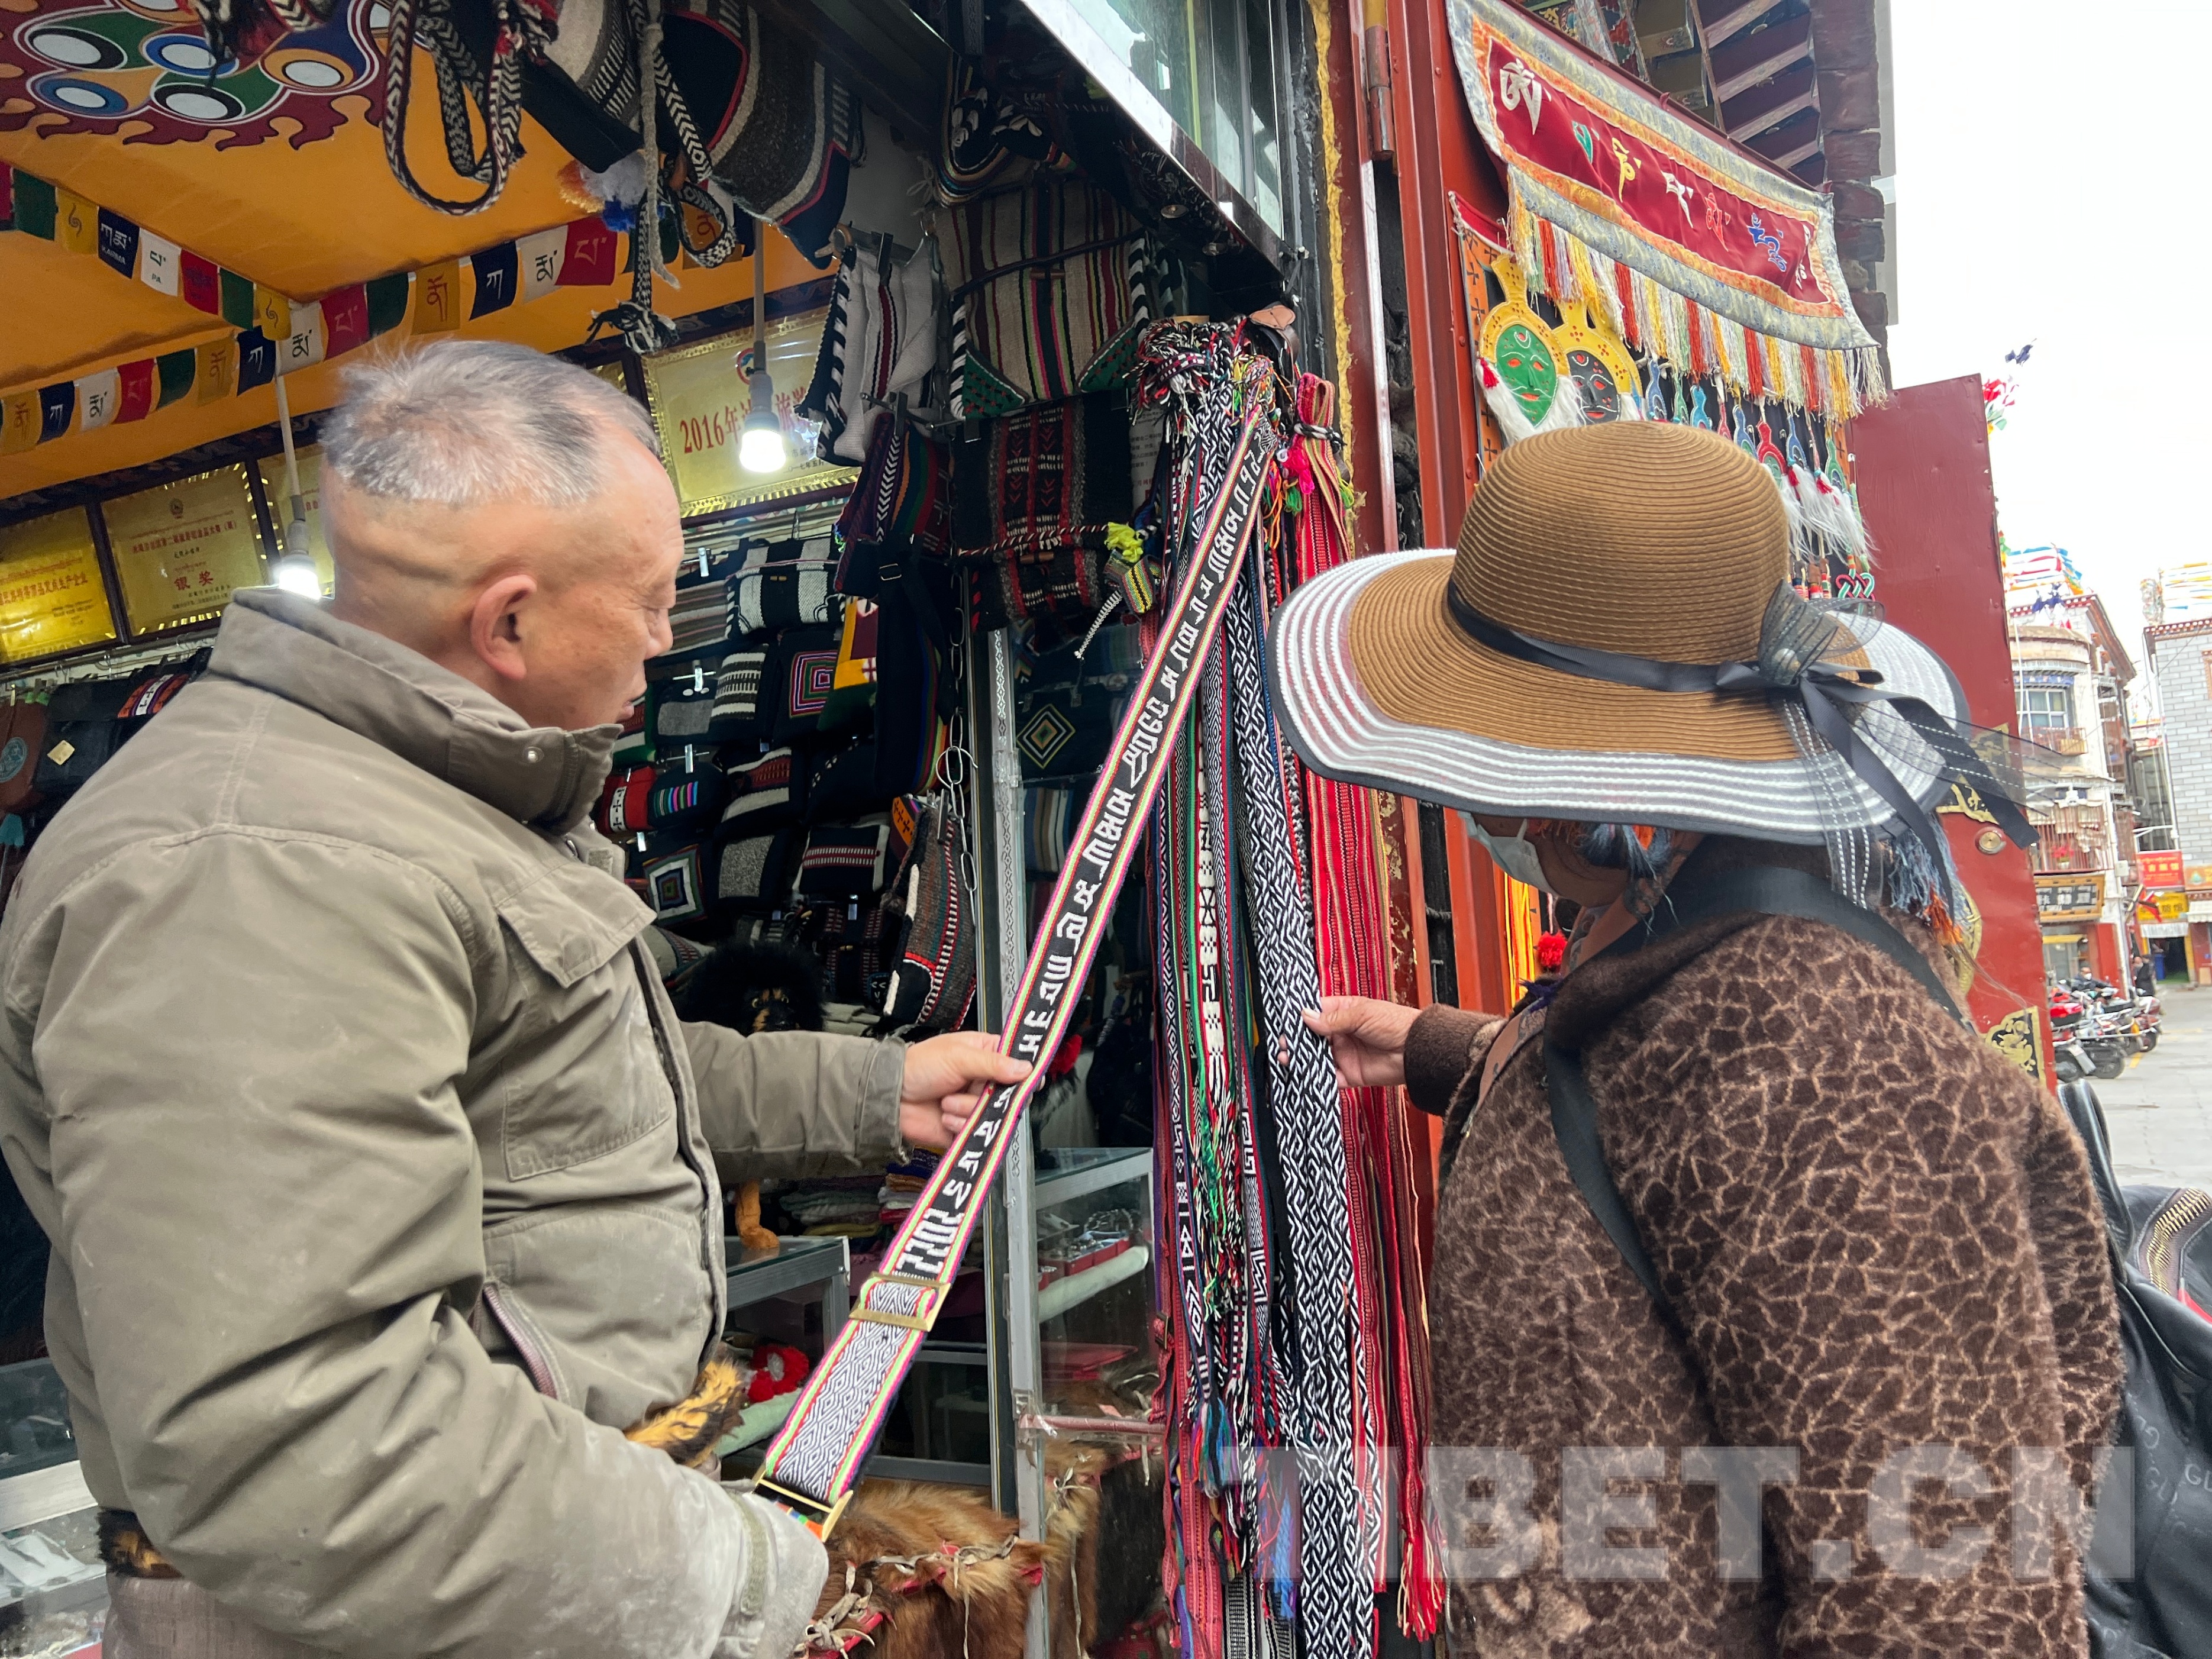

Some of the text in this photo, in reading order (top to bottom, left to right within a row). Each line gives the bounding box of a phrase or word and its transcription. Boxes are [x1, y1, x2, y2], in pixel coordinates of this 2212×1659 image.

[102, 245, 126, 264] KARMA
[151, 273, 161, 283] PA
[896, 1208, 965, 1274] 2022
